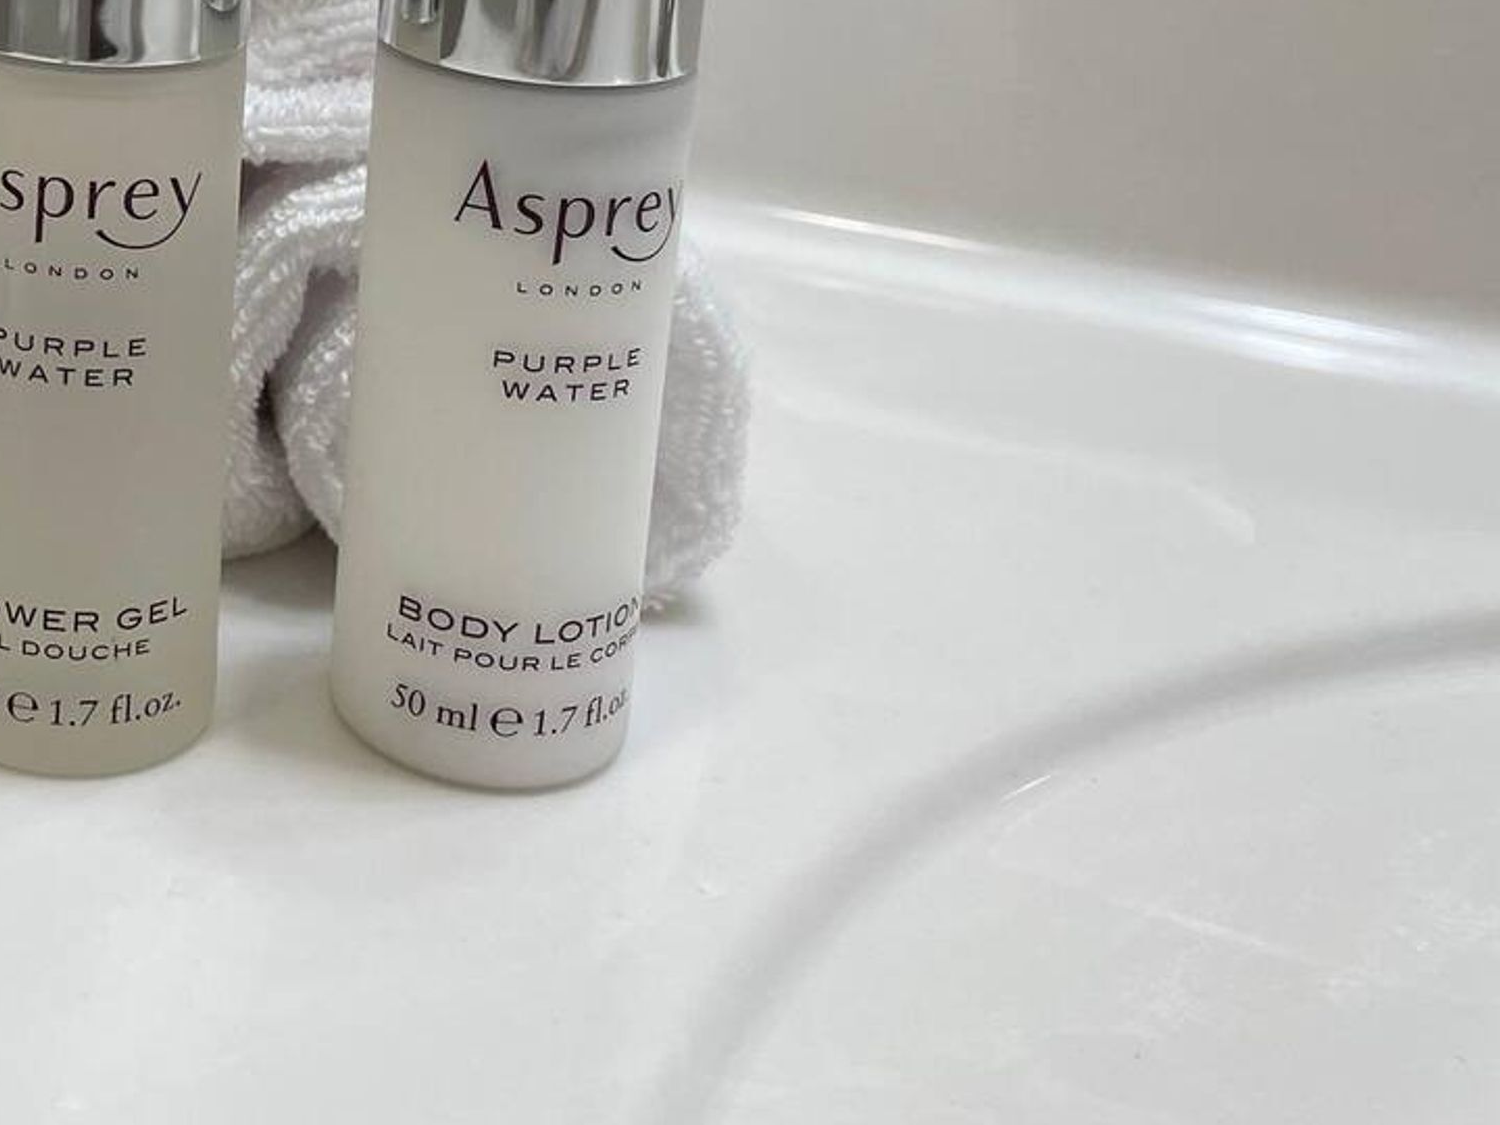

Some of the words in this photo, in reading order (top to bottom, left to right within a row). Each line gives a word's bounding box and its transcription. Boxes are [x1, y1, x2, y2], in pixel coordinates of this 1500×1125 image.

[454, 158, 683, 266] Asprey
[4, 258, 139, 280] LONDON
[516, 279, 642, 297] LONDON
[493, 347, 641, 374] PURPLE
[501, 378, 630, 402] WATER
[116, 596, 188, 630] GEL
[398, 595, 518, 643] BODY
[21, 638, 151, 661] DOUCHE
[386, 622, 444, 656] LAIT
[453, 647, 540, 671] POUR
[550, 652, 582, 671] LE
[589, 624, 638, 663] CORP
[50, 700, 99, 727] 1.7
[110, 692, 182, 724] fl.oz.
[390, 683, 426, 716] 50
[436, 703, 478, 732] ml
[533, 706, 578, 736] 1.7
